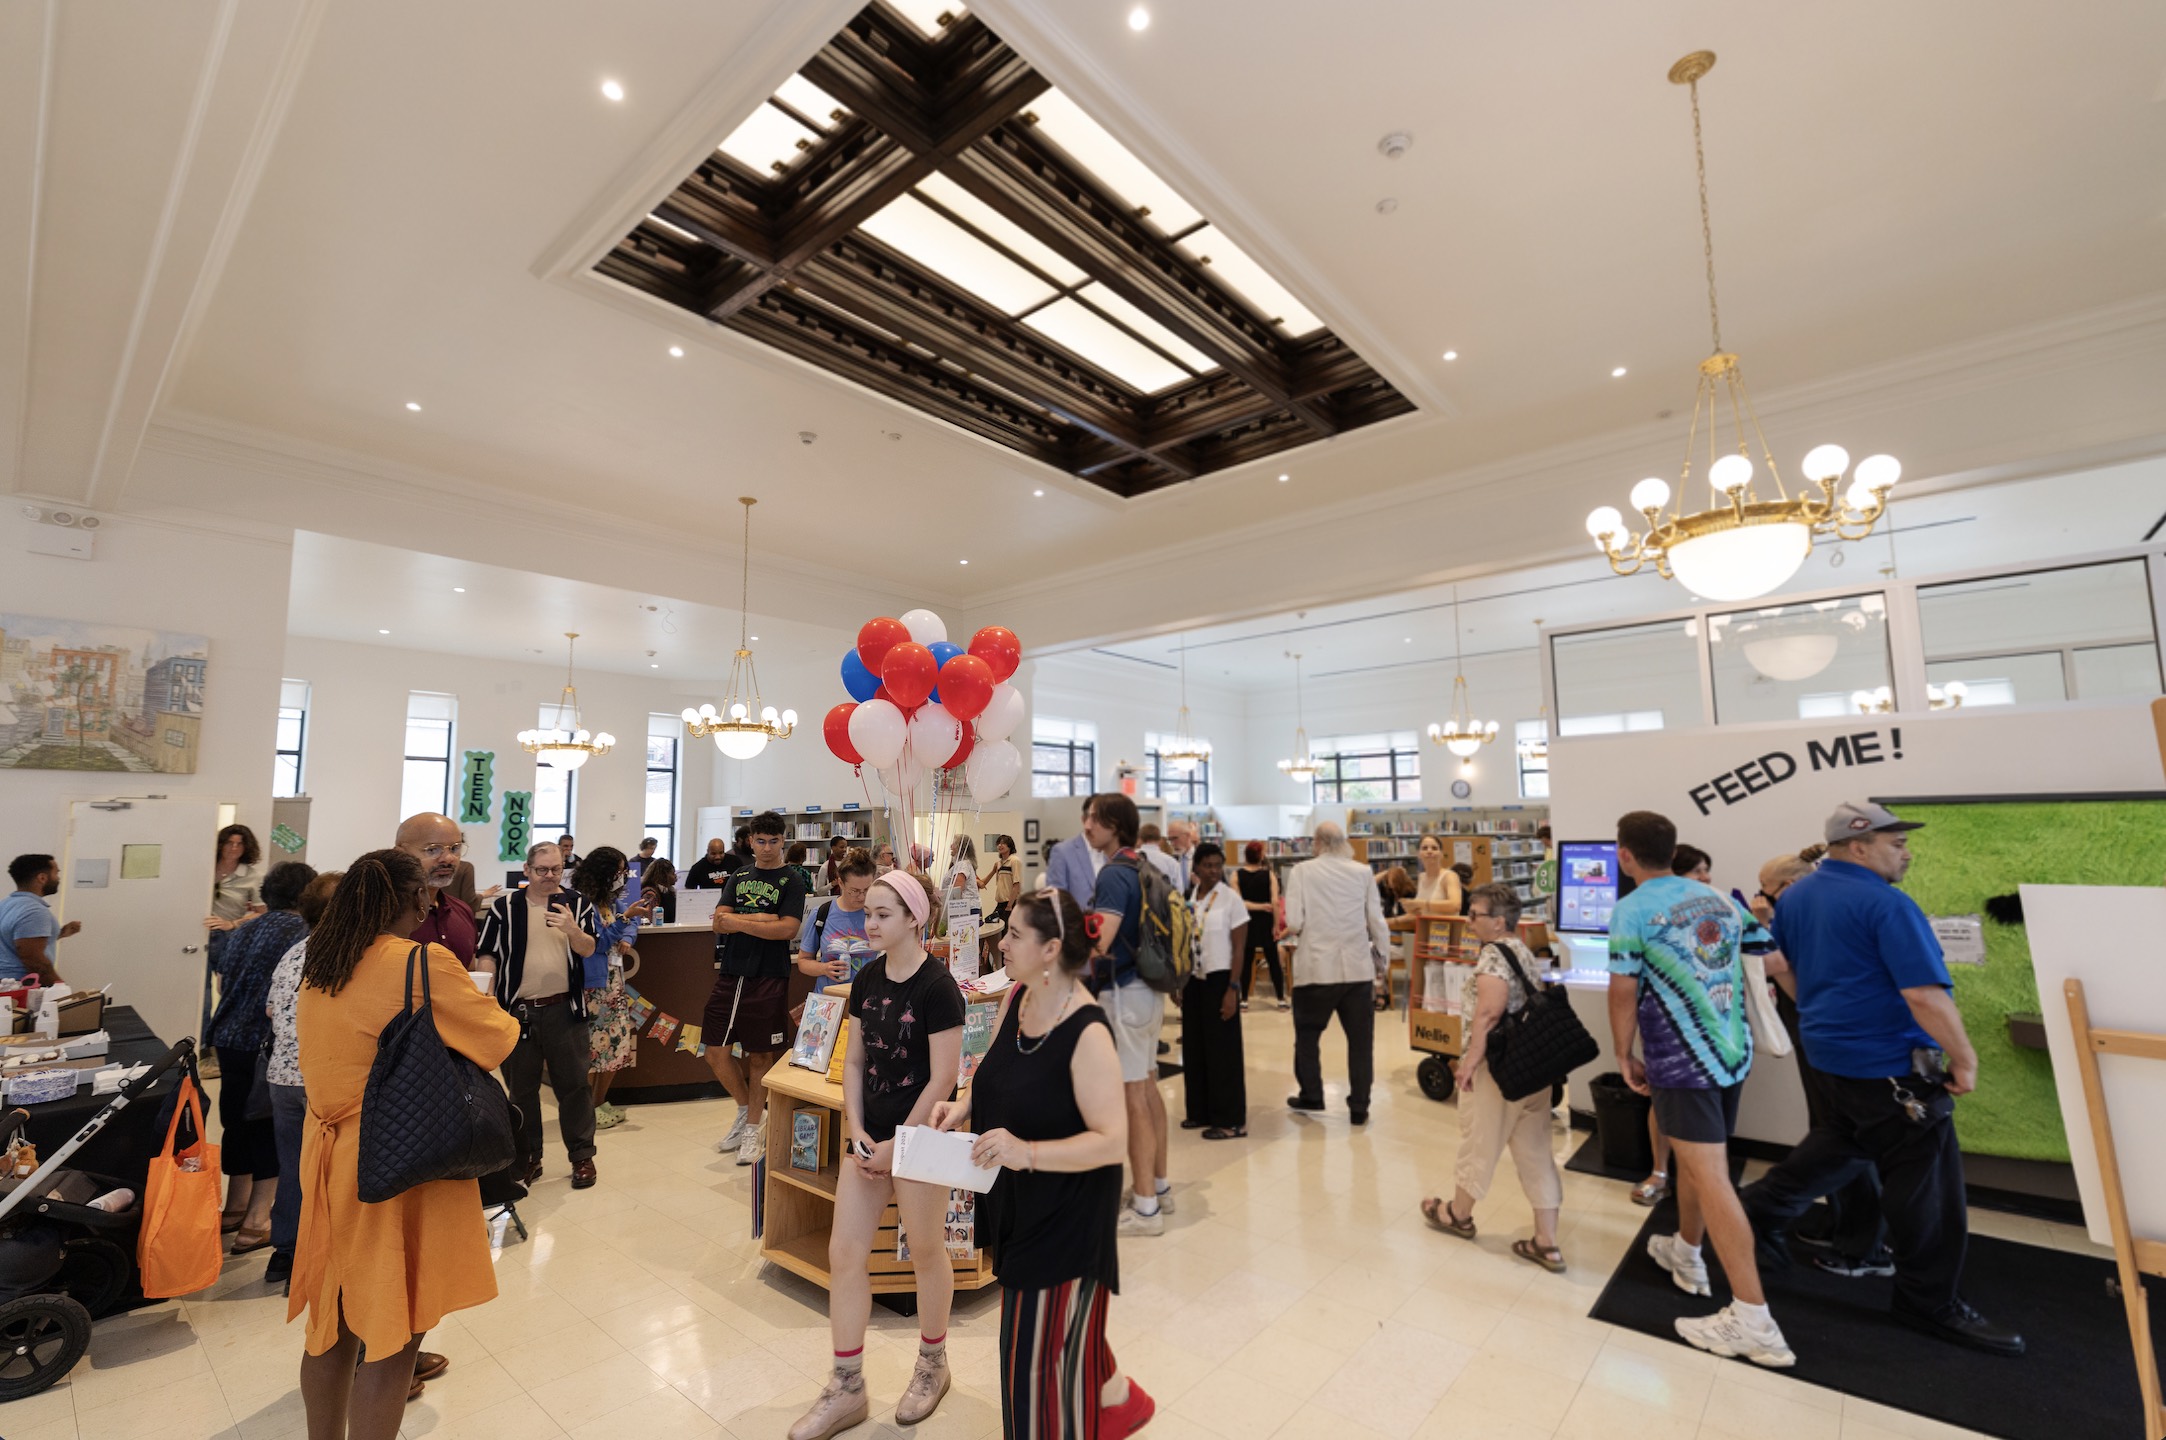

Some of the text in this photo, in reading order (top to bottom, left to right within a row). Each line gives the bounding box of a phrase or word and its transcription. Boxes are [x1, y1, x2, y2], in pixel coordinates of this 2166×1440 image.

[468, 757, 486, 816] TEEN
[1688, 751, 1797, 816] FEED
[507, 797, 524, 856] NOOK
[735, 880, 780, 905] JAMAICA
[965, 1012, 984, 1025] OT
[968, 1025, 985, 1033] Quiet
[1415, 1024, 1451, 1044] Nellie
